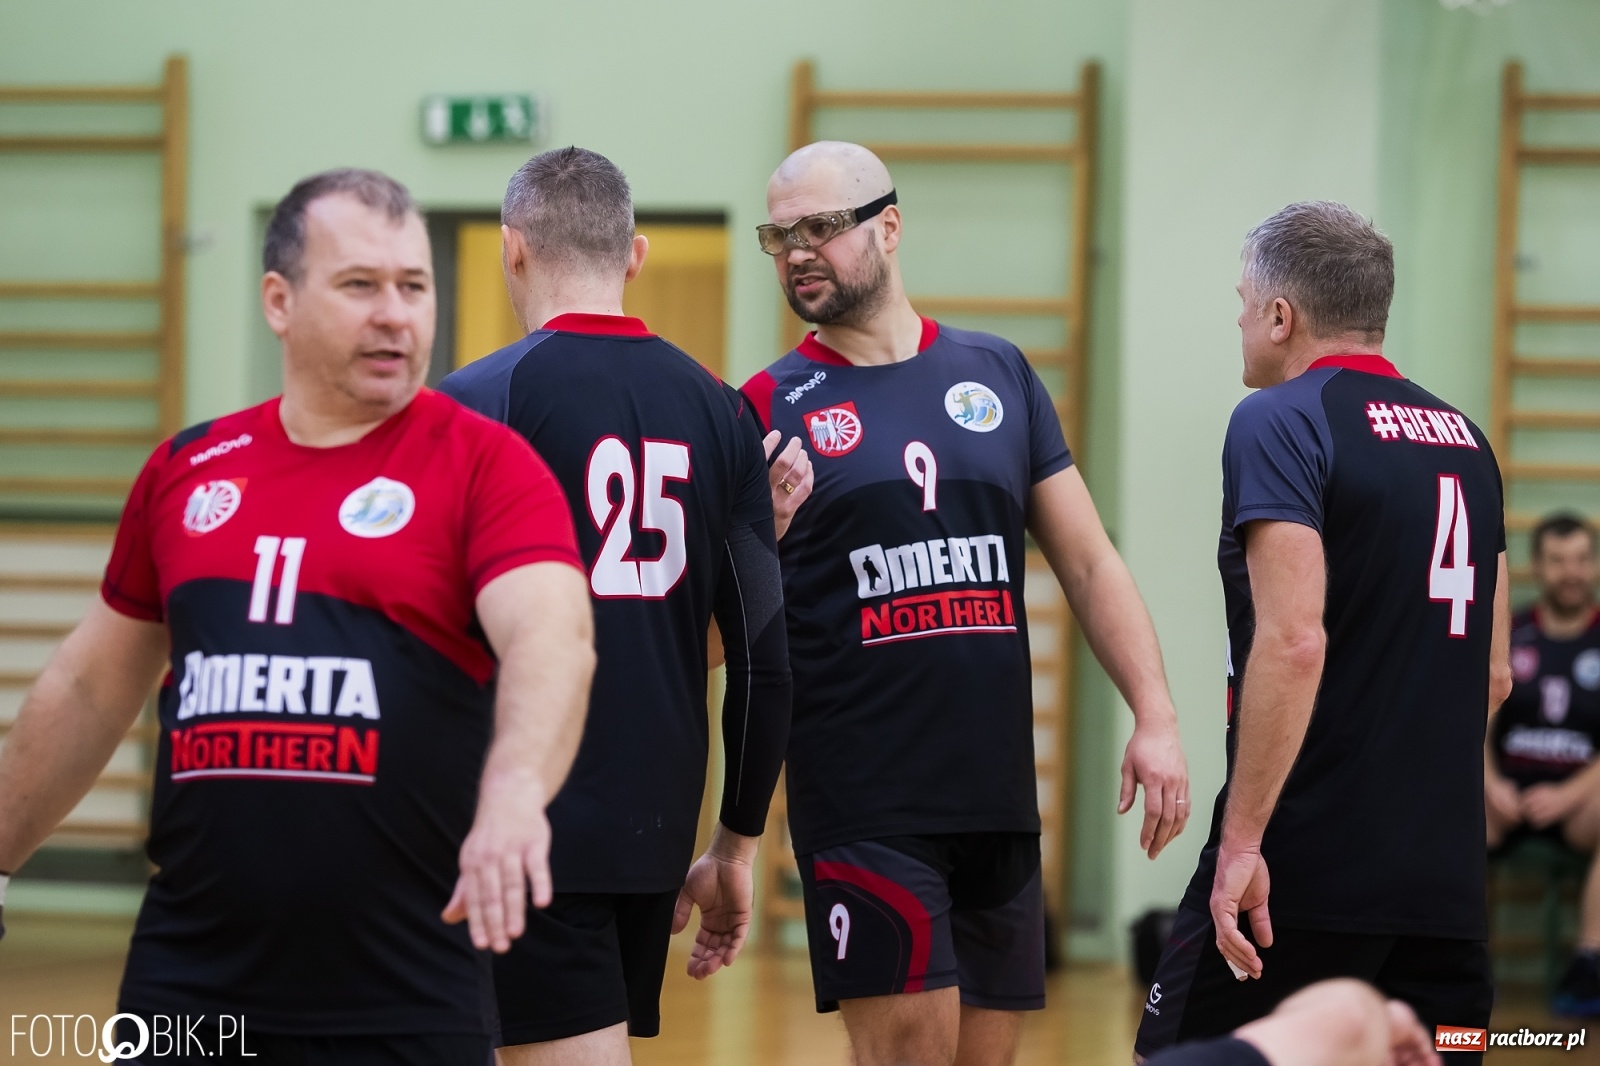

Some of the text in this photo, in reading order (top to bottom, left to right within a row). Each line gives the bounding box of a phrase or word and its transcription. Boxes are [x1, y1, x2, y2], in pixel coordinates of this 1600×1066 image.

[904, 441, 938, 512] 9
[585, 435, 691, 599] 25
[1429, 474, 1475, 638] 4
[248, 535, 307, 624] 11
[170, 721, 379, 776] NORTHERN
[829, 903, 850, 960] 9
